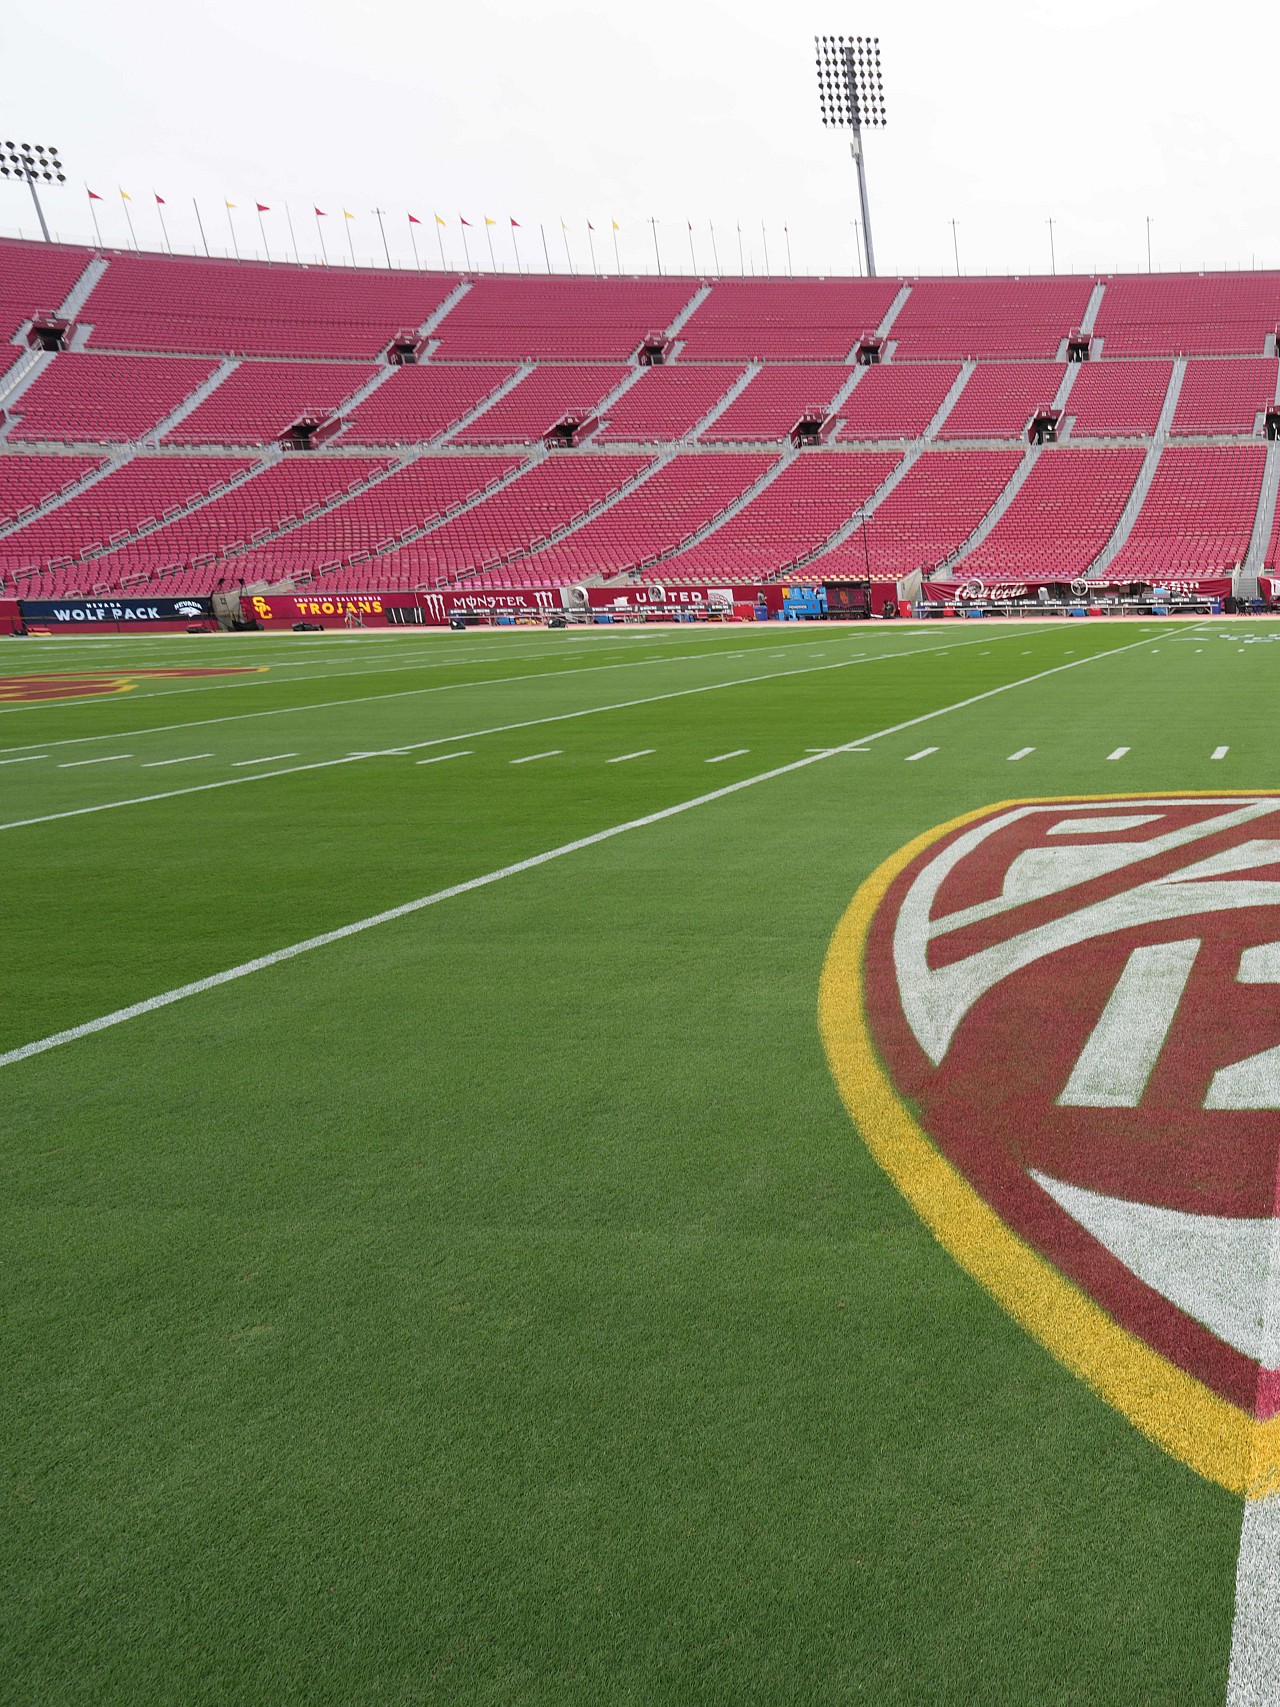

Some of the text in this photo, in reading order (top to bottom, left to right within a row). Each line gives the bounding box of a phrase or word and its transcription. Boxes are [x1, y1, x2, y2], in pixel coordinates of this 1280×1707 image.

[635, 591, 702, 602] UTED
[53, 607, 161, 621] WOLF PACK
[296, 601, 383, 615] TROJANS
